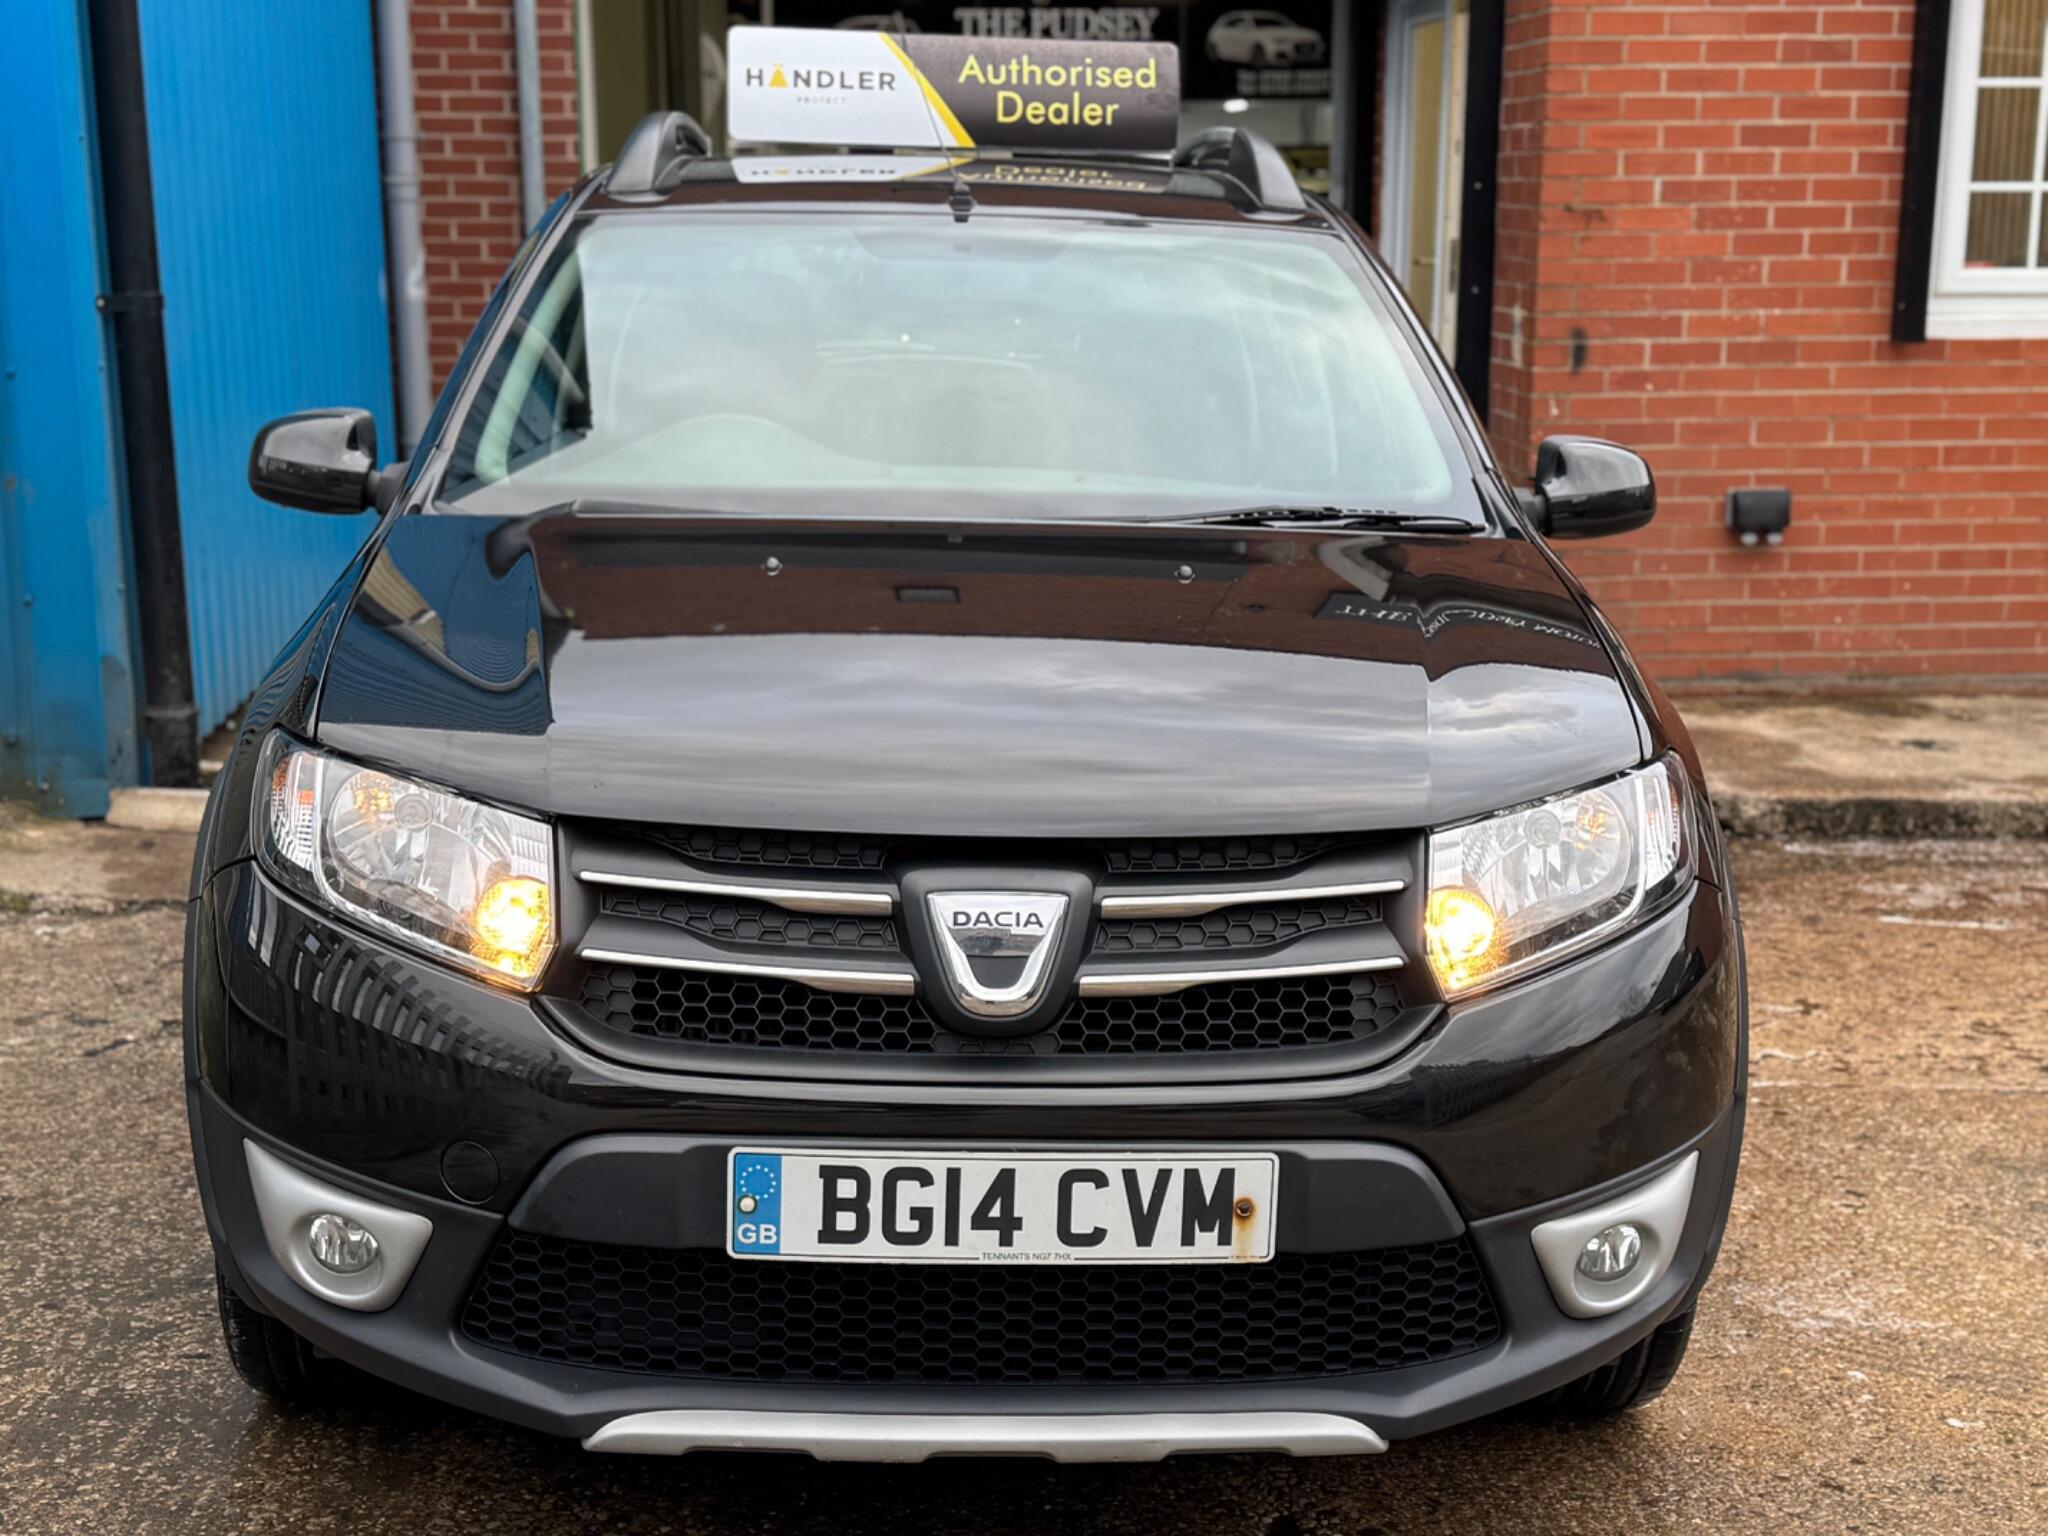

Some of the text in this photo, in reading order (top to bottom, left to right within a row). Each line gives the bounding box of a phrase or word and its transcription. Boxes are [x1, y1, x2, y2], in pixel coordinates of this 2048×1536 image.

[953, 7, 1160, 40] THE PUDSEY
[958, 54, 1157, 89] Authorised
[996, 90, 1120, 126] Dealer
[953, 911, 1044, 928] DACIA
[817, 1164, 1236, 1248] BG14 CVM
[736, 1223, 778, 1245] GB
[982, 1252, 1031, 1261] TENNANTS
